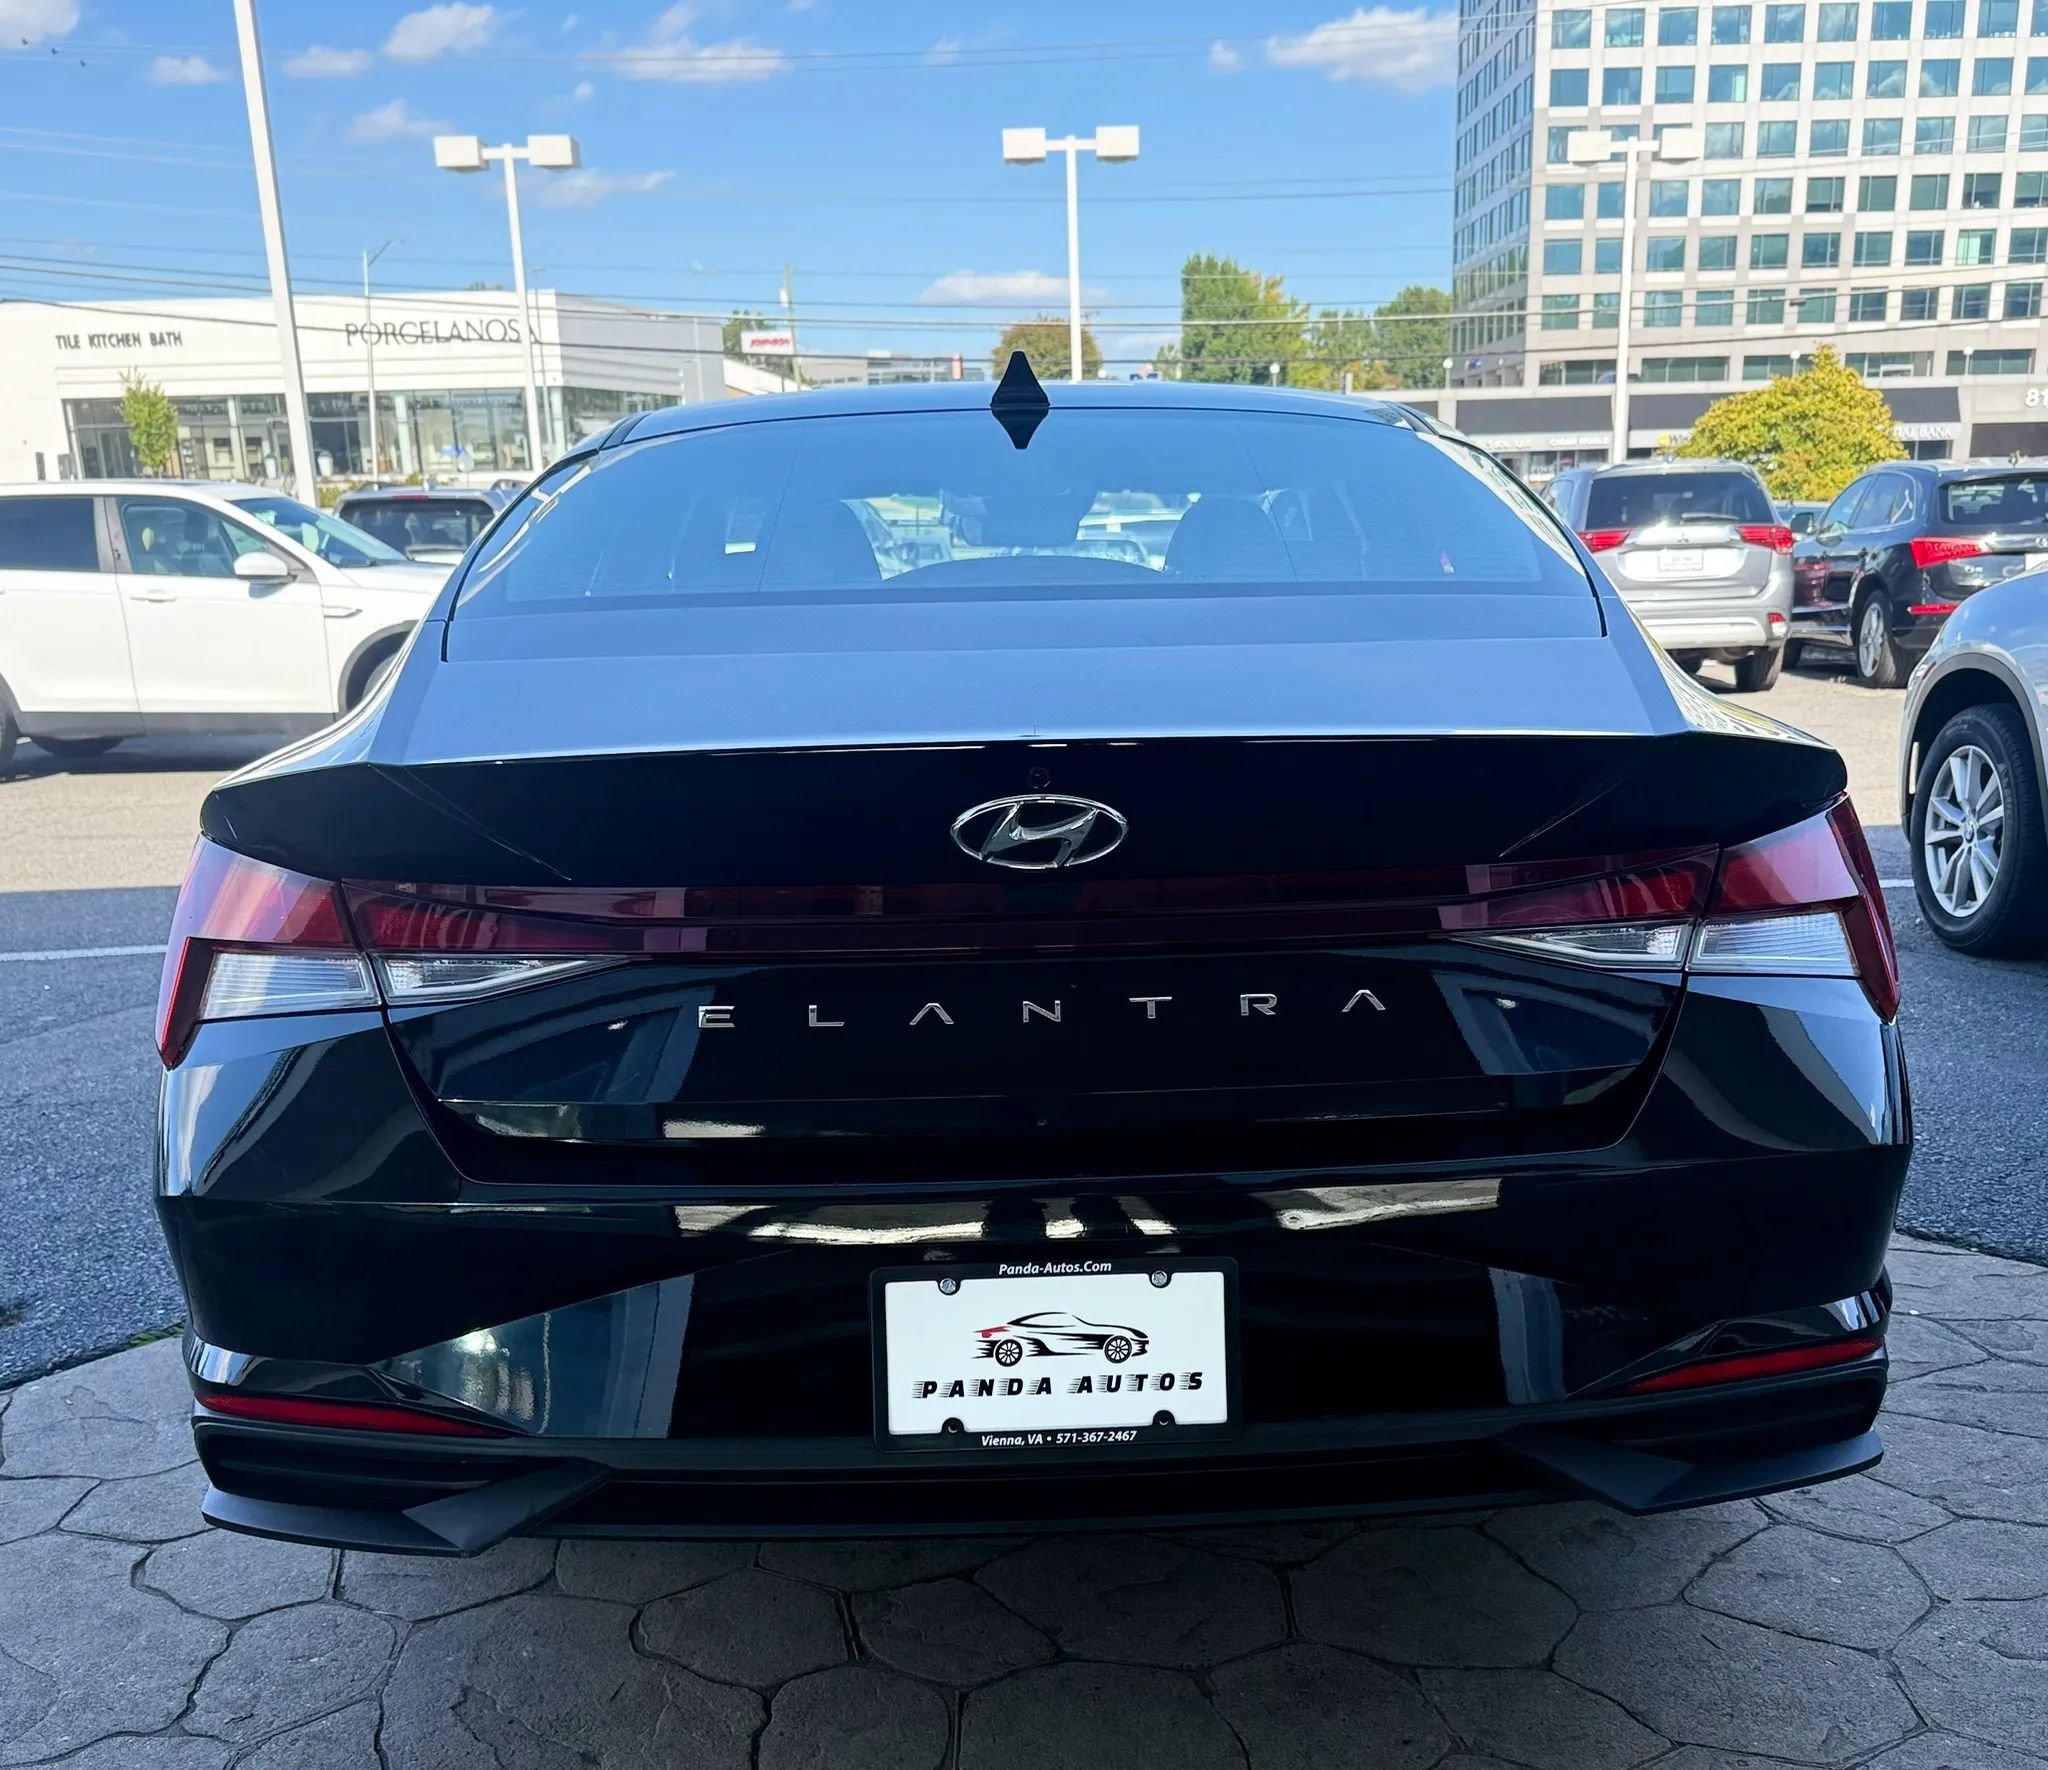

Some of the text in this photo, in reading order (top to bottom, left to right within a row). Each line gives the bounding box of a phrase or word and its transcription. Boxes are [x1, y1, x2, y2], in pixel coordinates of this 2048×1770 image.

[55, 331, 182, 349] TILE KITCHEN BATH
[699, 989, 1386, 1028] ELANTRA
[999, 1261, 1112, 1275] Panda-Autos.Com
[912, 1371, 1203, 1399] PANDA AUTOS
[981, 1430, 1138, 1447] Vienna, VA 571-367-2467
